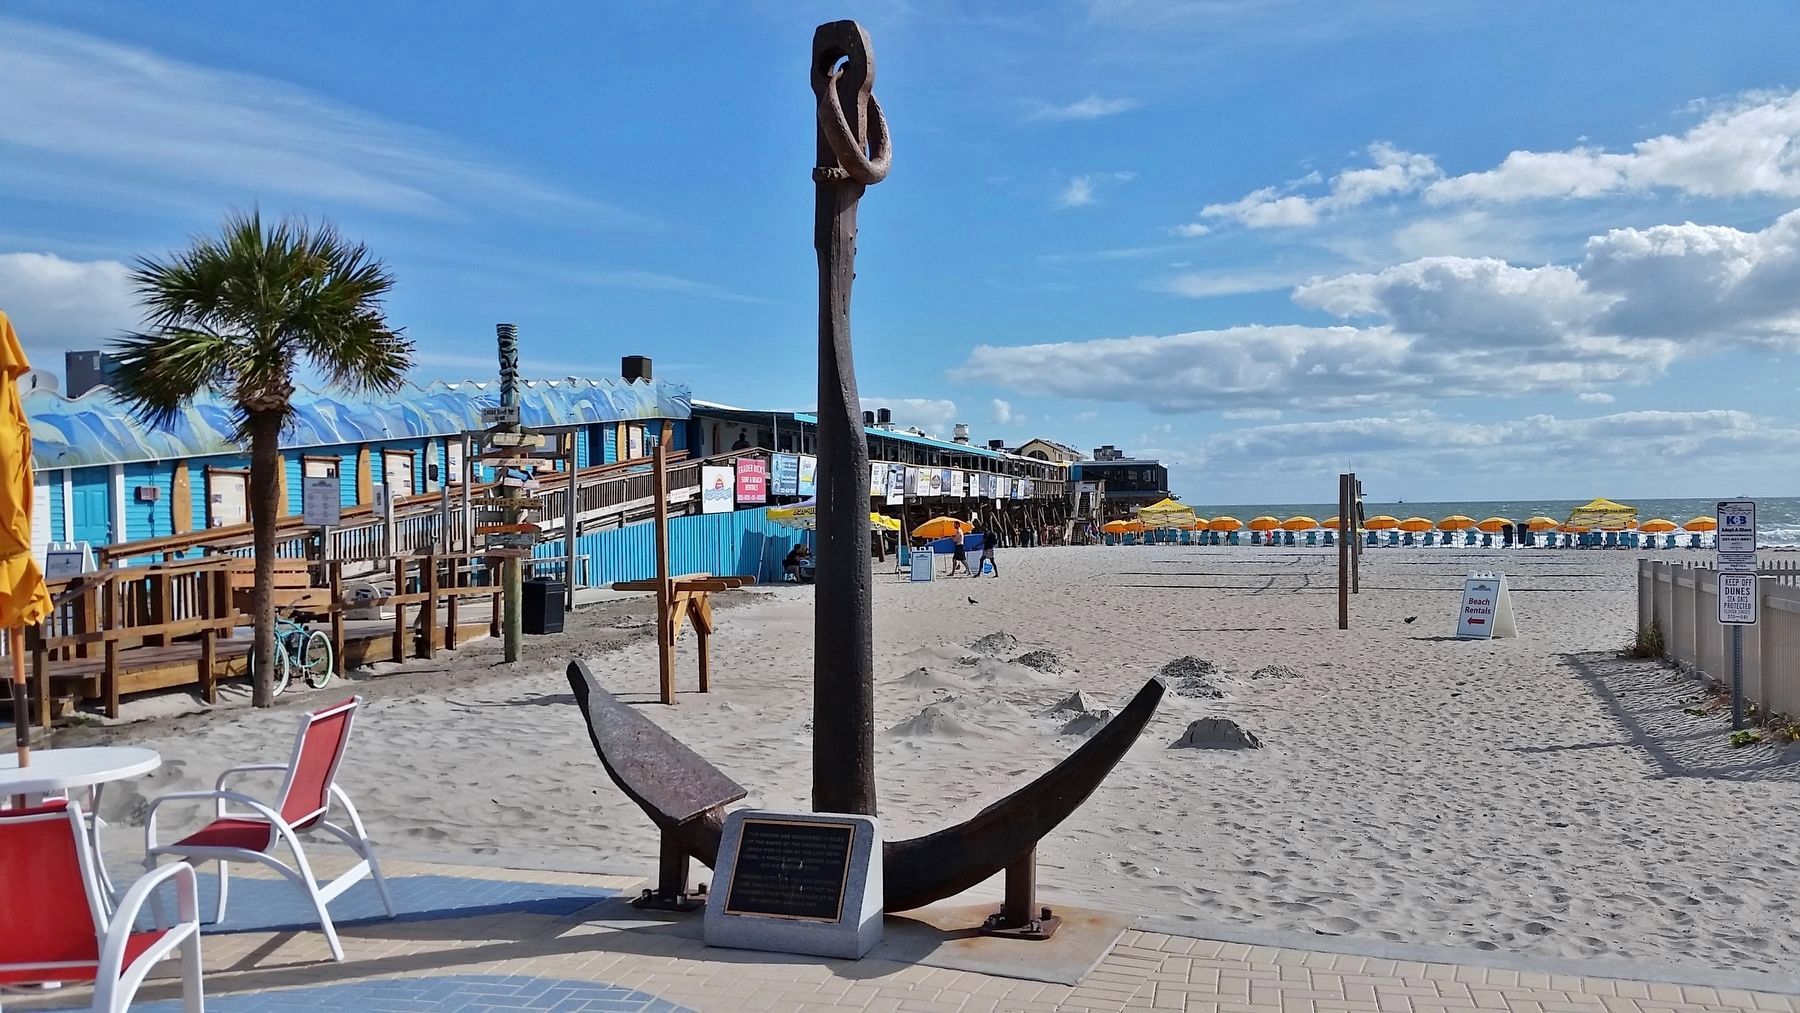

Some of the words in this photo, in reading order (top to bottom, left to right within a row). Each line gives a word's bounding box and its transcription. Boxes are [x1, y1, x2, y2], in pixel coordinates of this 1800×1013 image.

[1725, 578, 1739, 586] KEEP
[1741, 578, 1753, 586] OFF
[1725, 587, 1751, 595] DUNES
[1469, 597, 1490, 605] Beach
[1464, 606, 1491, 614] Rentals
[1724, 602, 1752, 610] PROTECTED
